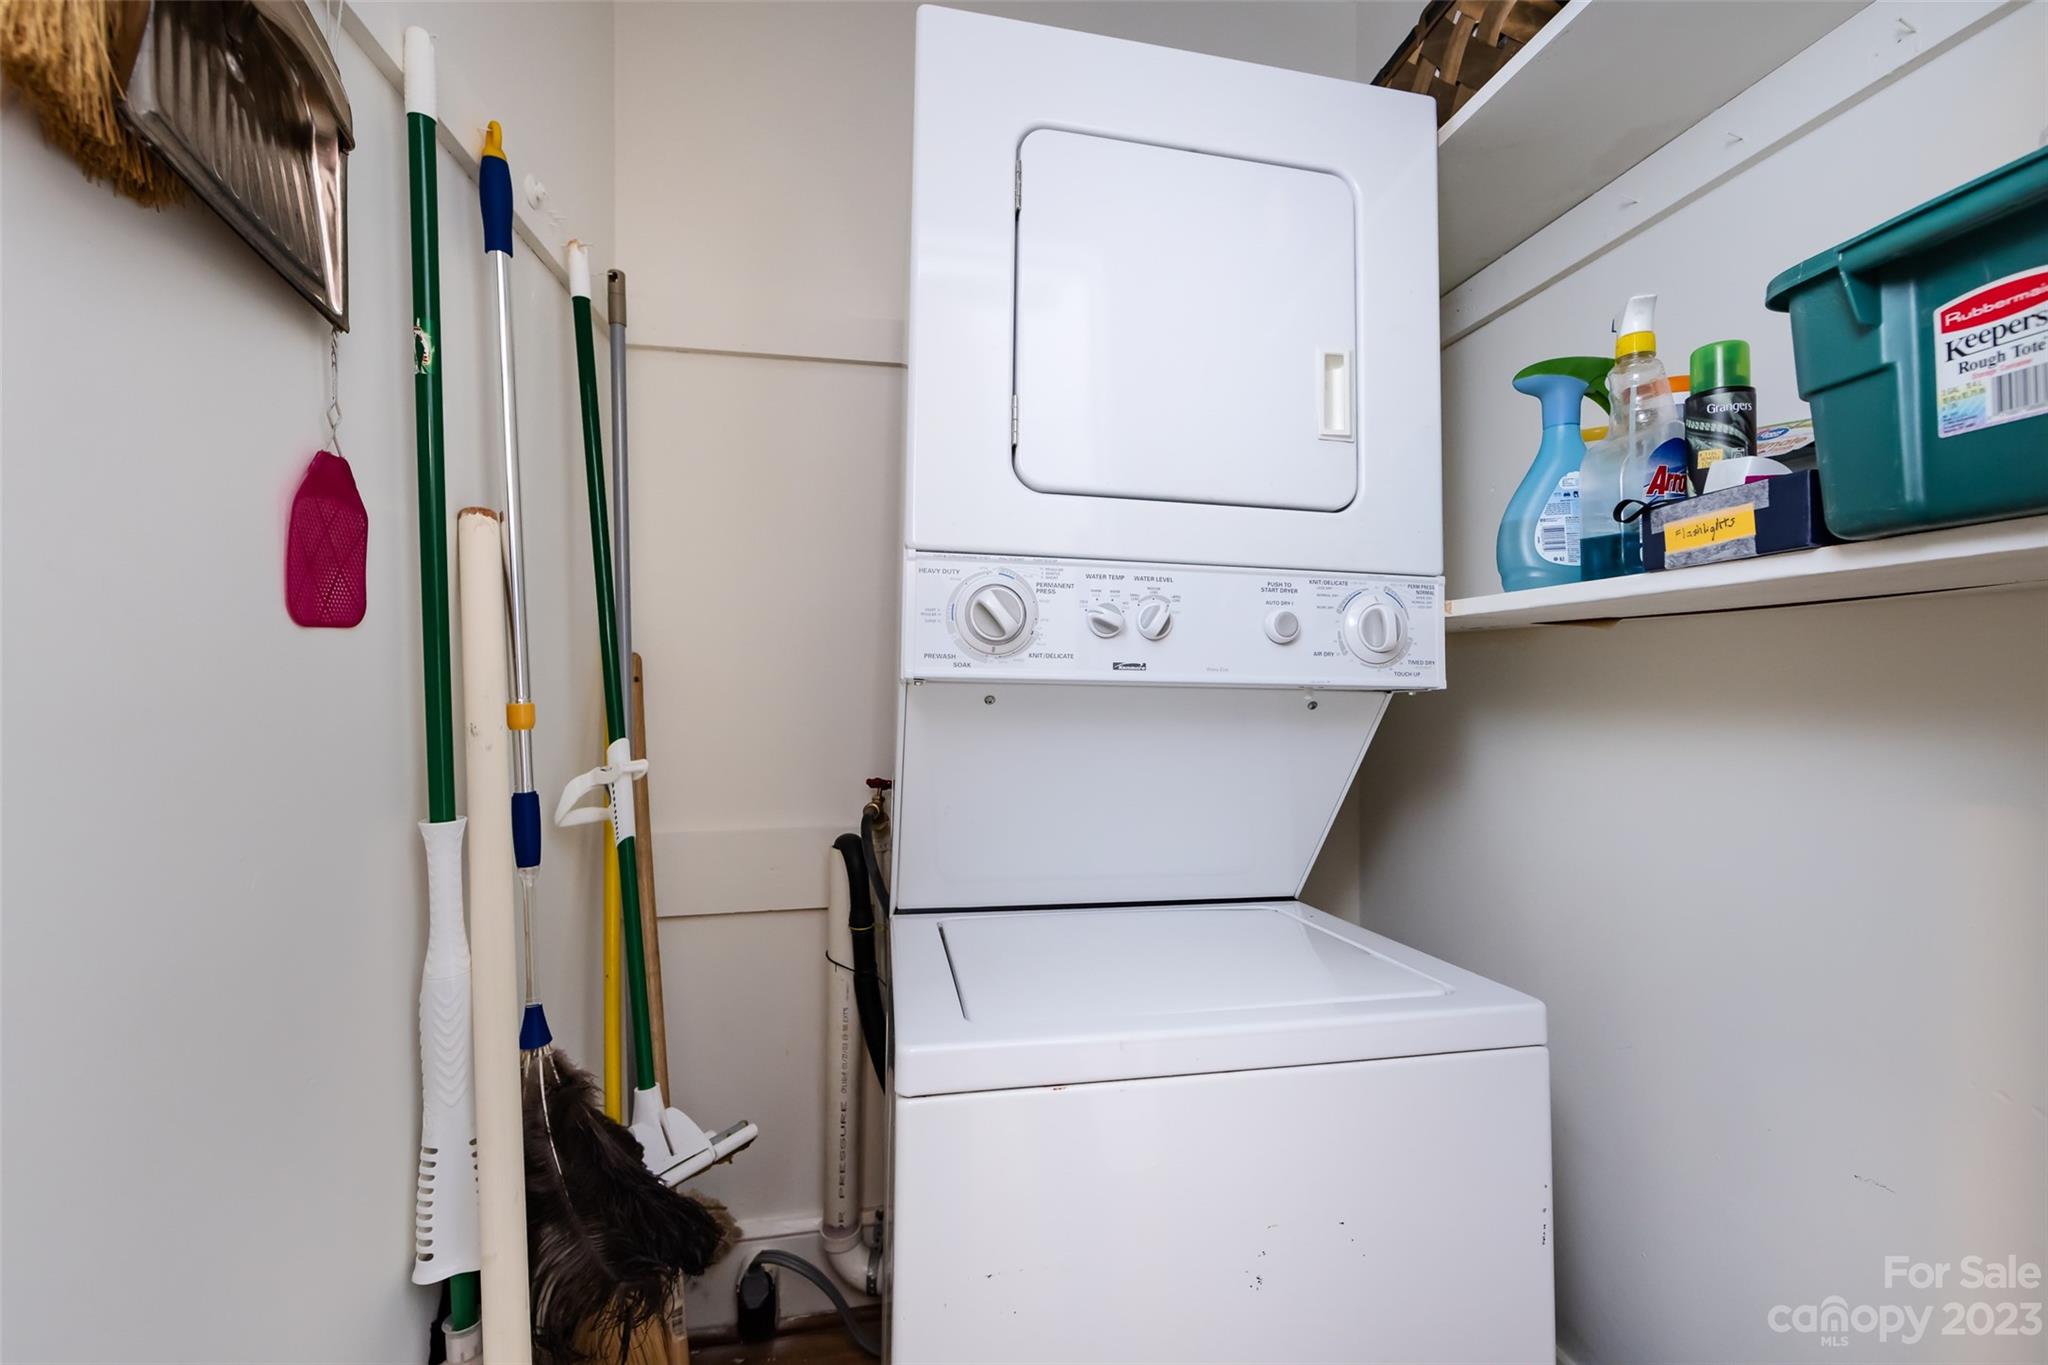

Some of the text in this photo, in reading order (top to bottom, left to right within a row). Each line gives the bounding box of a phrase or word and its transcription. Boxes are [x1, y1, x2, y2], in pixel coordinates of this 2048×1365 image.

[1945, 309, 2048, 362] Keepers
[1958, 340, 2046, 374] Rough Tote
[1706, 401, 1753, 414] Grangers
[918, 567, 940, 575] HEAVY
[838, 1101, 848, 1199] PRESSURE
